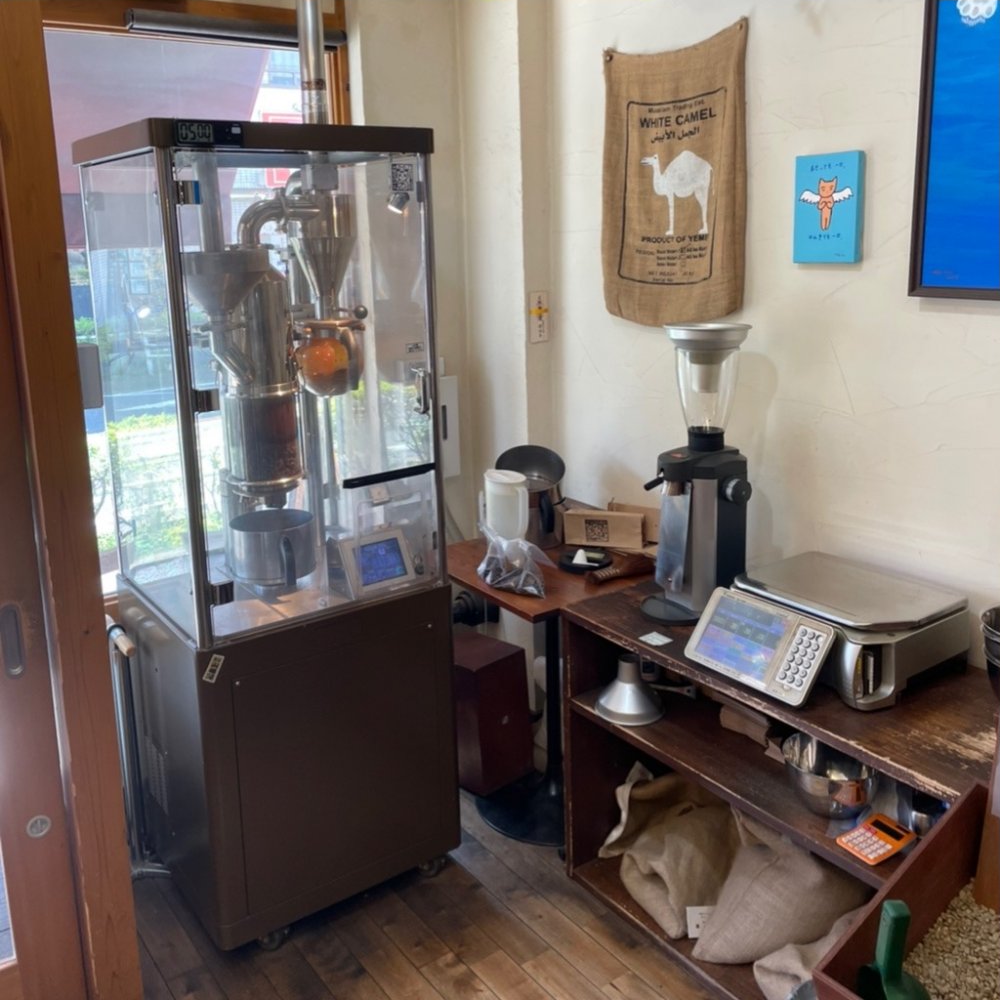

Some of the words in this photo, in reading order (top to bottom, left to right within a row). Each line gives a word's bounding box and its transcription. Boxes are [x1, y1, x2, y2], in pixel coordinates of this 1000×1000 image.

[640, 115, 672, 128] WHITE
[675, 107, 717, 126] CAMEL
[641, 235, 674, 244] PRODUCT
